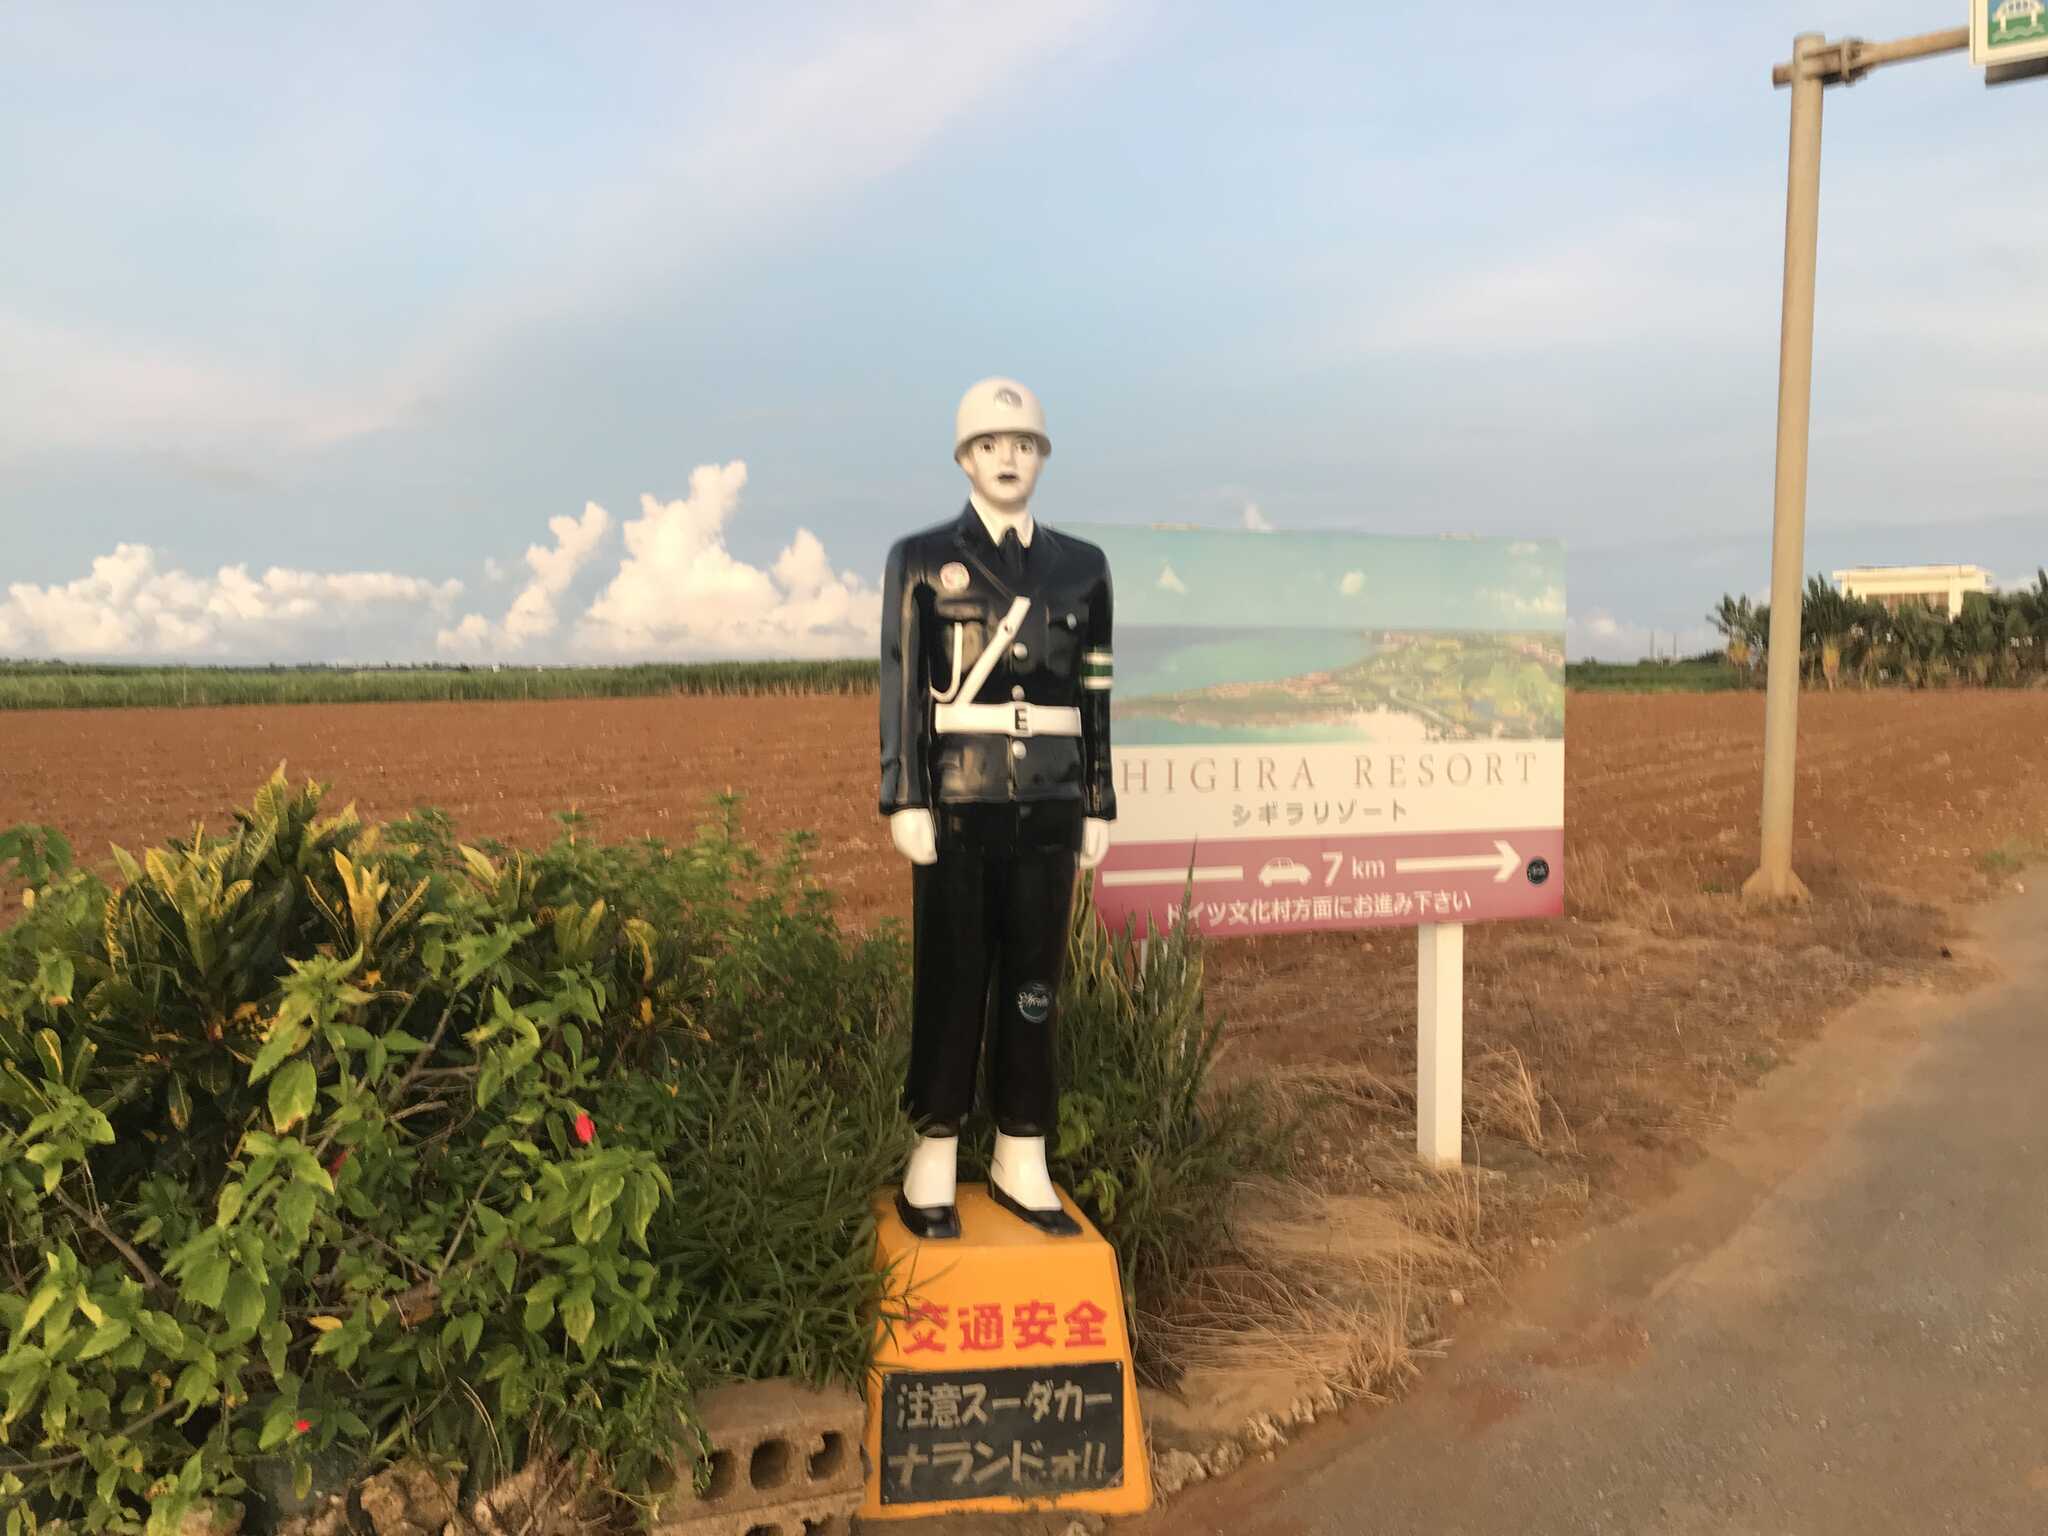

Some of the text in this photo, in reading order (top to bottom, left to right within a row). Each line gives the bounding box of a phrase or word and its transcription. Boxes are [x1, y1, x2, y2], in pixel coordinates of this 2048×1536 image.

[1353, 751, 1538, 790] RESORT
[1232, 799, 1408, 828] シギラリゾート
[1321, 850, 1386, 888] 7 km
[1167, 888, 1472, 930] ドイツ文化村方面にお進み下さい
[903, 1299, 1108, 1355] 交通安全
[896, 1378, 1113, 1430] 注意スーダカー
